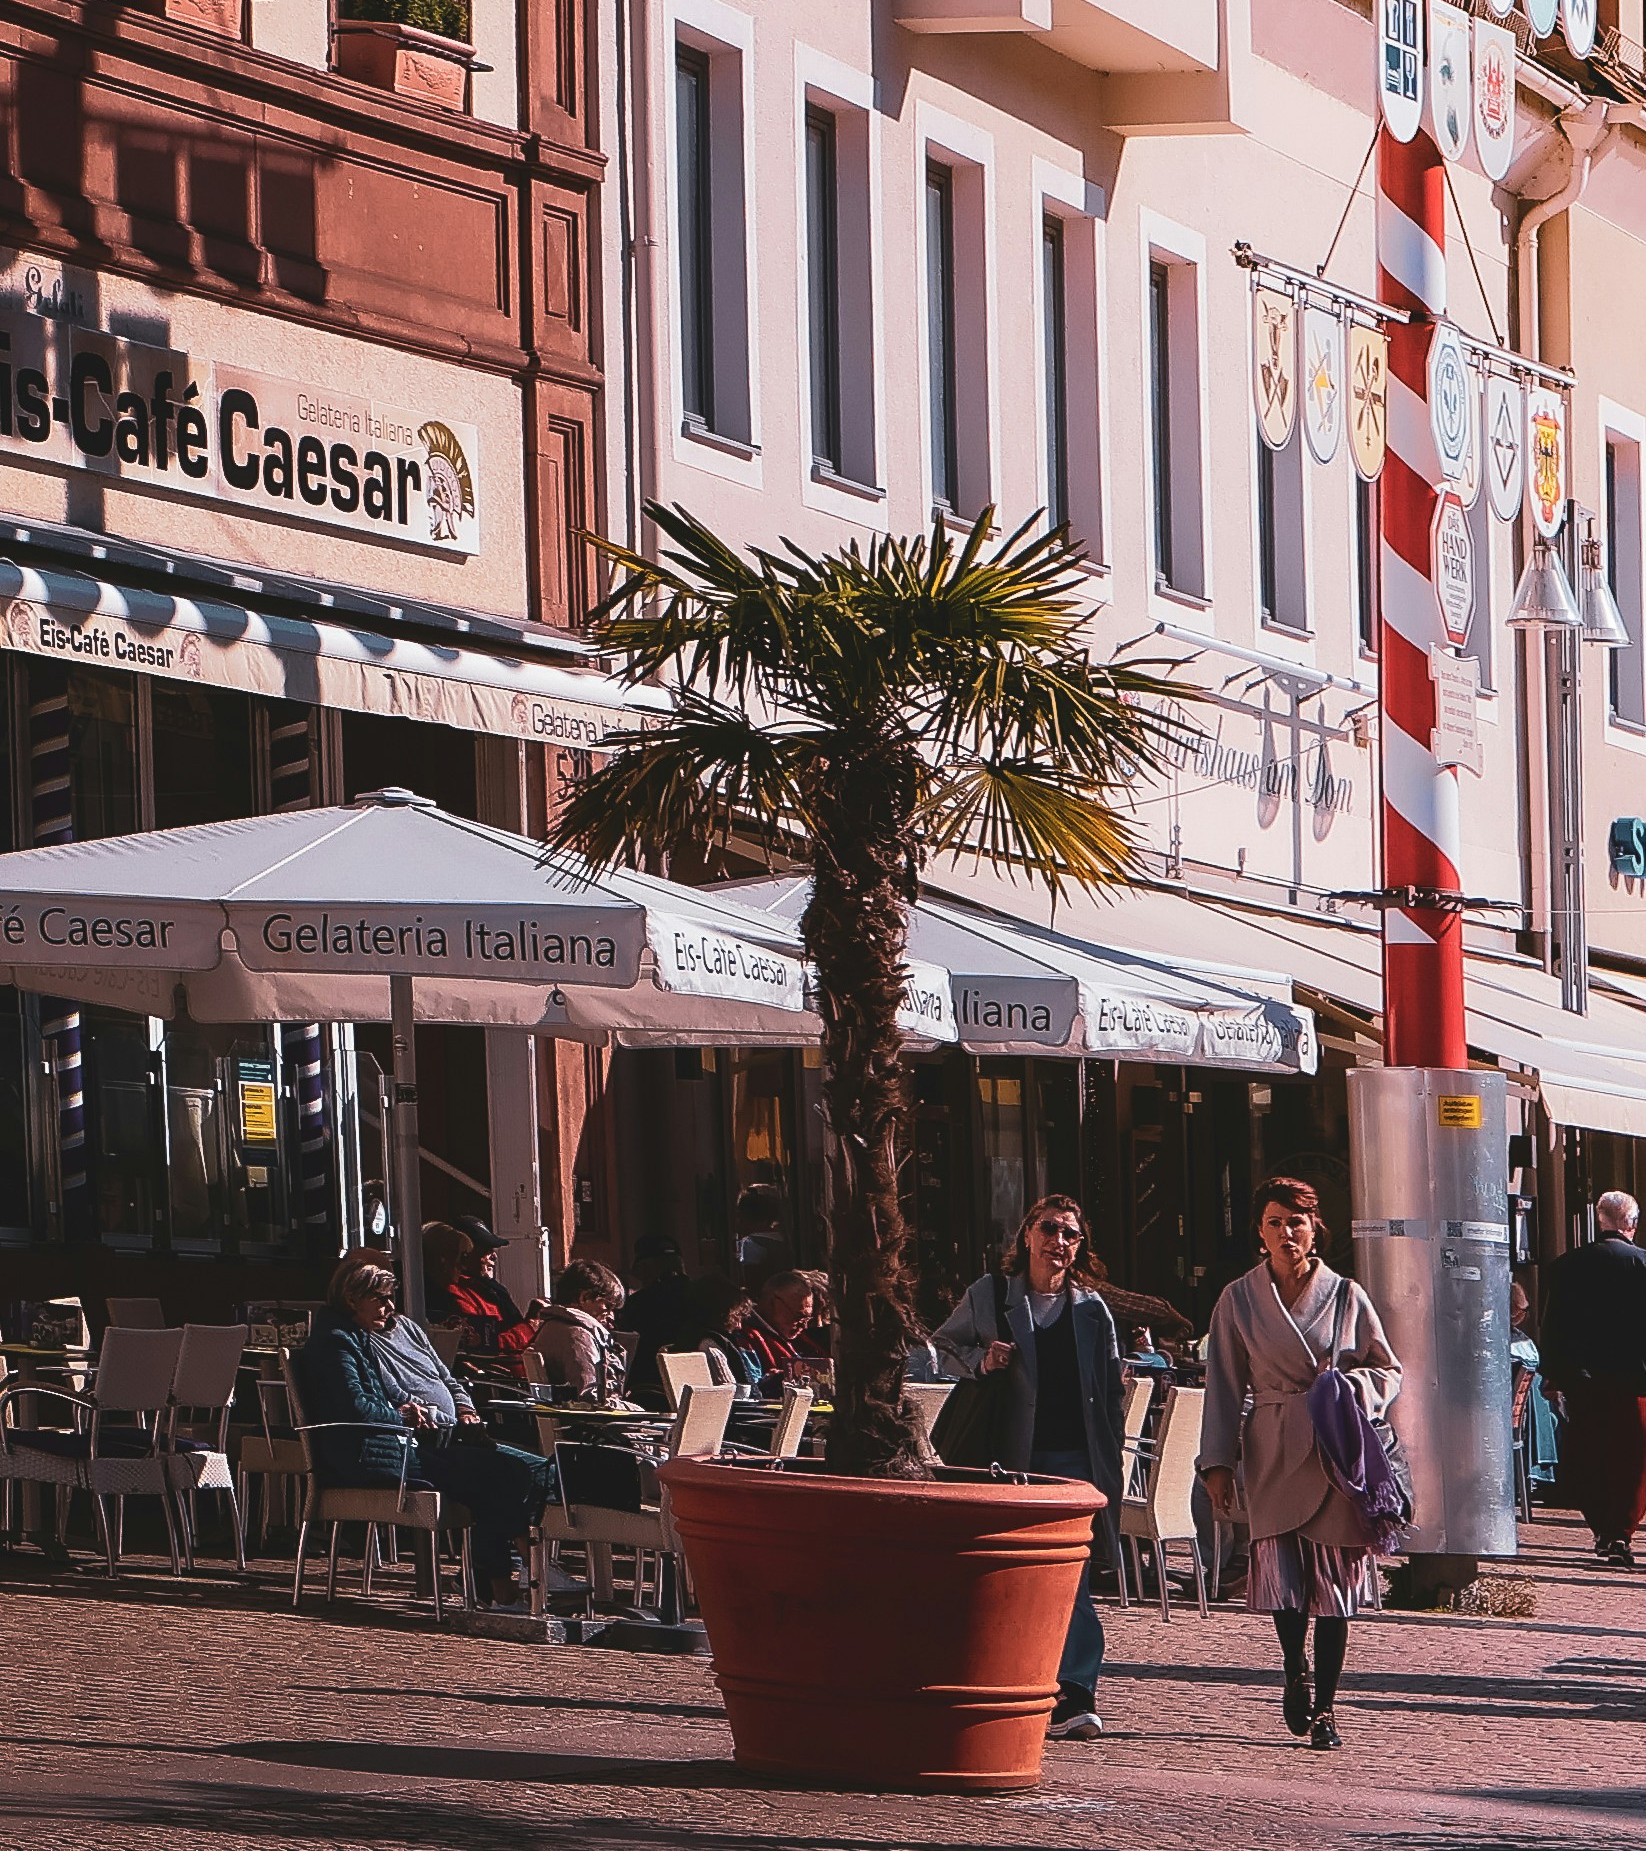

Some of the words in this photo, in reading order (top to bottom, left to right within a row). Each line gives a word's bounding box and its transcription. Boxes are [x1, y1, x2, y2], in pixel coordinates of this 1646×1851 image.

[297, 394, 360, 433] Gelateria
[364, 409, 413, 446] Italiana
[219, 388, 422, 525] Caesar
[1442, 532, 1467, 559] HAND
[1443, 554, 1467, 583] WERK
[39, 618, 110, 657] Eis-Café
[114, 632, 173, 668] Caesar
[532, 703, 597, 742] Gelateria
[38, 907, 175, 948] Caesar
[263, 913, 448, 958] Gelateria
[466, 920, 616, 967] Italiana
[674, 932, 737, 977] Eis-Café
[953, 989, 1050, 1032] liana
